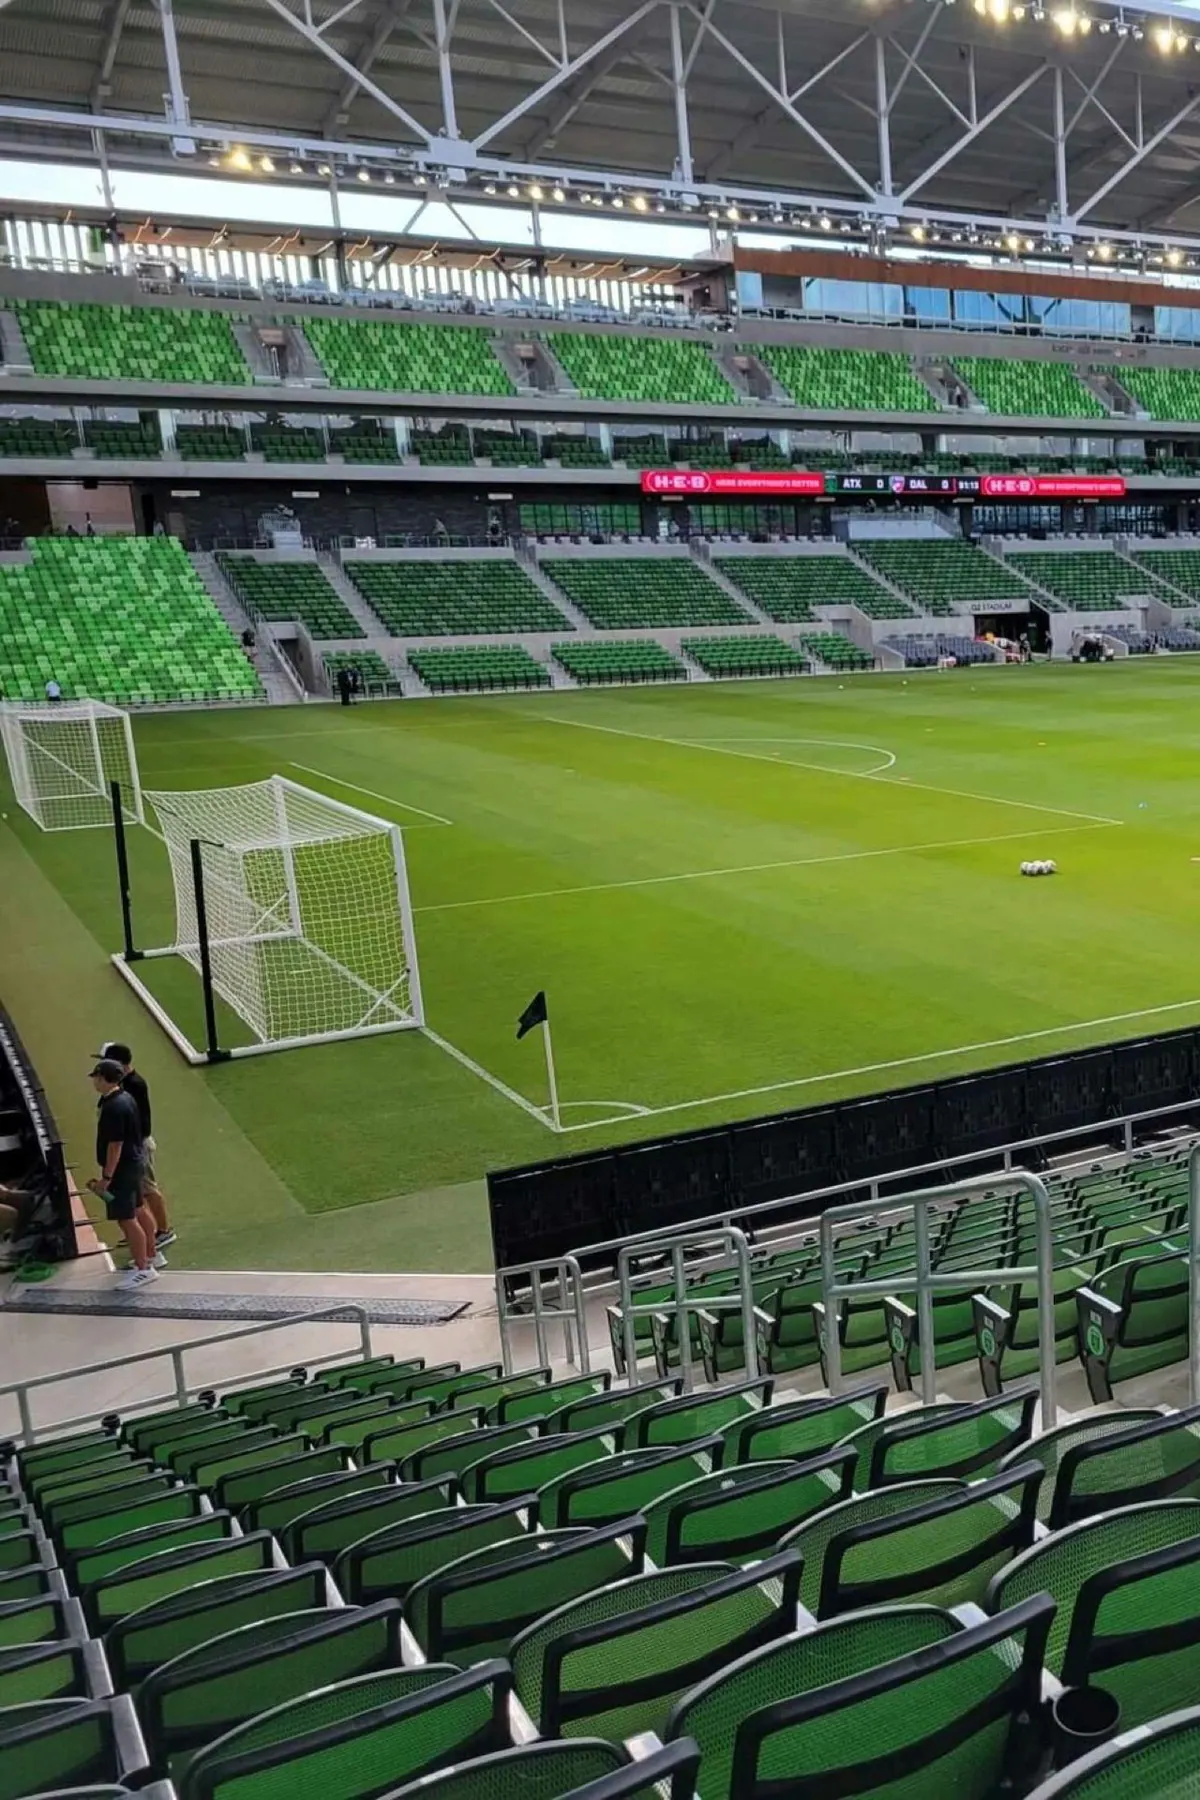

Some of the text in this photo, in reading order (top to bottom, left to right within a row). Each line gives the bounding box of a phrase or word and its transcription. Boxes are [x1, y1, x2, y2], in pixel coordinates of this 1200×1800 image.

[843, 478, 862, 489] ATX
[909, 479, 928, 489] DAL
[982, 602, 1012, 611] STADIUM
